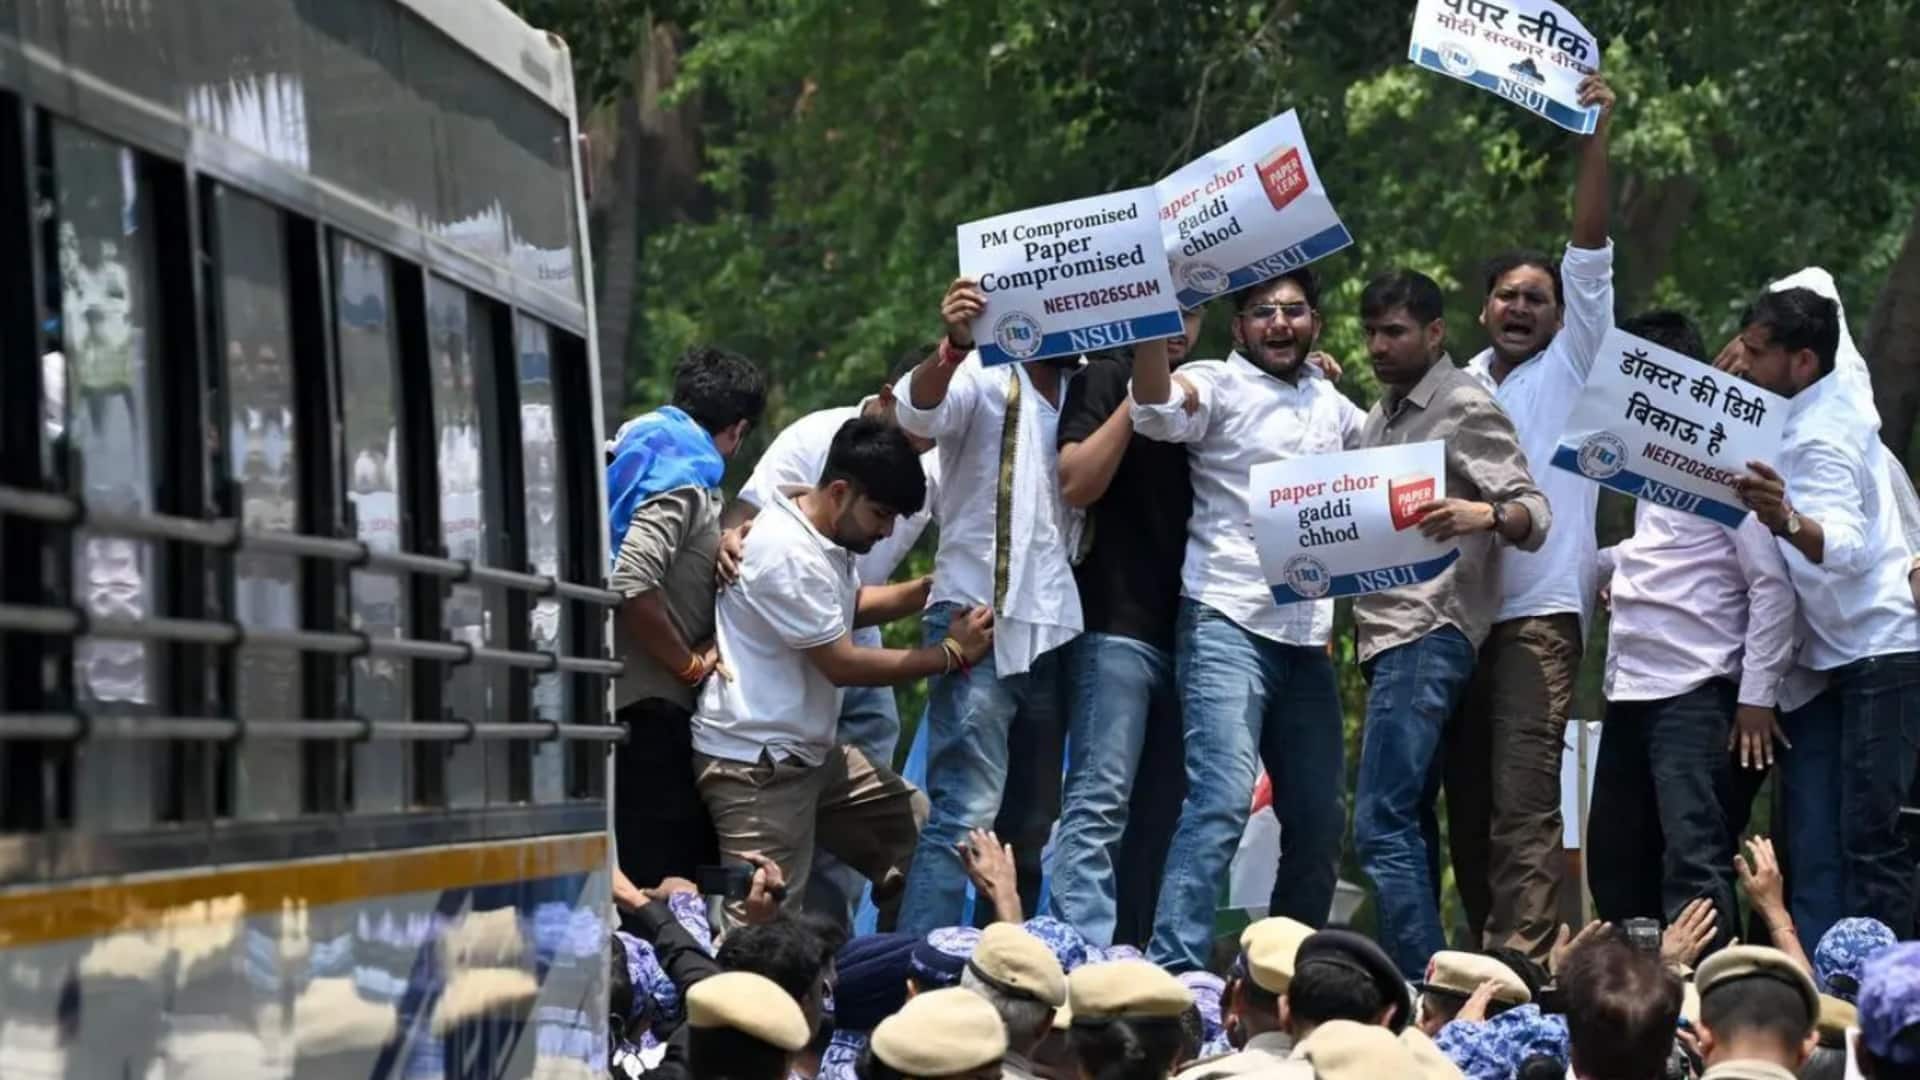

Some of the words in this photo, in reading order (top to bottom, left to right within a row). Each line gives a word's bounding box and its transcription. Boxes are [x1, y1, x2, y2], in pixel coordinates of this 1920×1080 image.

[1483, 29, 1544, 58] सरकार
[1517, 11, 1590, 61] लीक
[1498, 78, 1549, 114] NSUI
[1269, 157, 1300, 187] PAPER
[1276, 173, 1301, 195] LEAK
[1158, 188, 1201, 221] aper
[1205, 163, 1246, 195] chor
[981, 230, 1008, 248] PM
[1013, 202, 1139, 241] Compromised
[1177, 195, 1230, 240] gaddi
[1024, 236, 1092, 263] Paper
[1183, 216, 1243, 257] chhod
[980, 244, 1146, 294] Compromised
[1250, 245, 1311, 281] NSUI
[1043, 279, 1161, 315] NEET2026SCAM
[1069, 320, 1137, 351] NSUI
[1619, 348, 1686, 395] डॉक्टर
[1689, 375, 1721, 408] की
[1722, 386, 1767, 428] डिग्री
[1625, 391, 1704, 446] बिकाऊ
[1708, 422, 1727, 456] है
[1641, 442, 1744, 492] NEET2026SC
[1269, 481, 1326, 508] paper
[1332, 474, 1379, 494] chor
[1398, 487, 1432, 506] PAPER
[1638, 478, 1702, 514] NSUI
[1298, 498, 1352, 529] gaddi
[1299, 522, 1360, 548] chhod
[1355, 565, 1420, 593] NSUI
